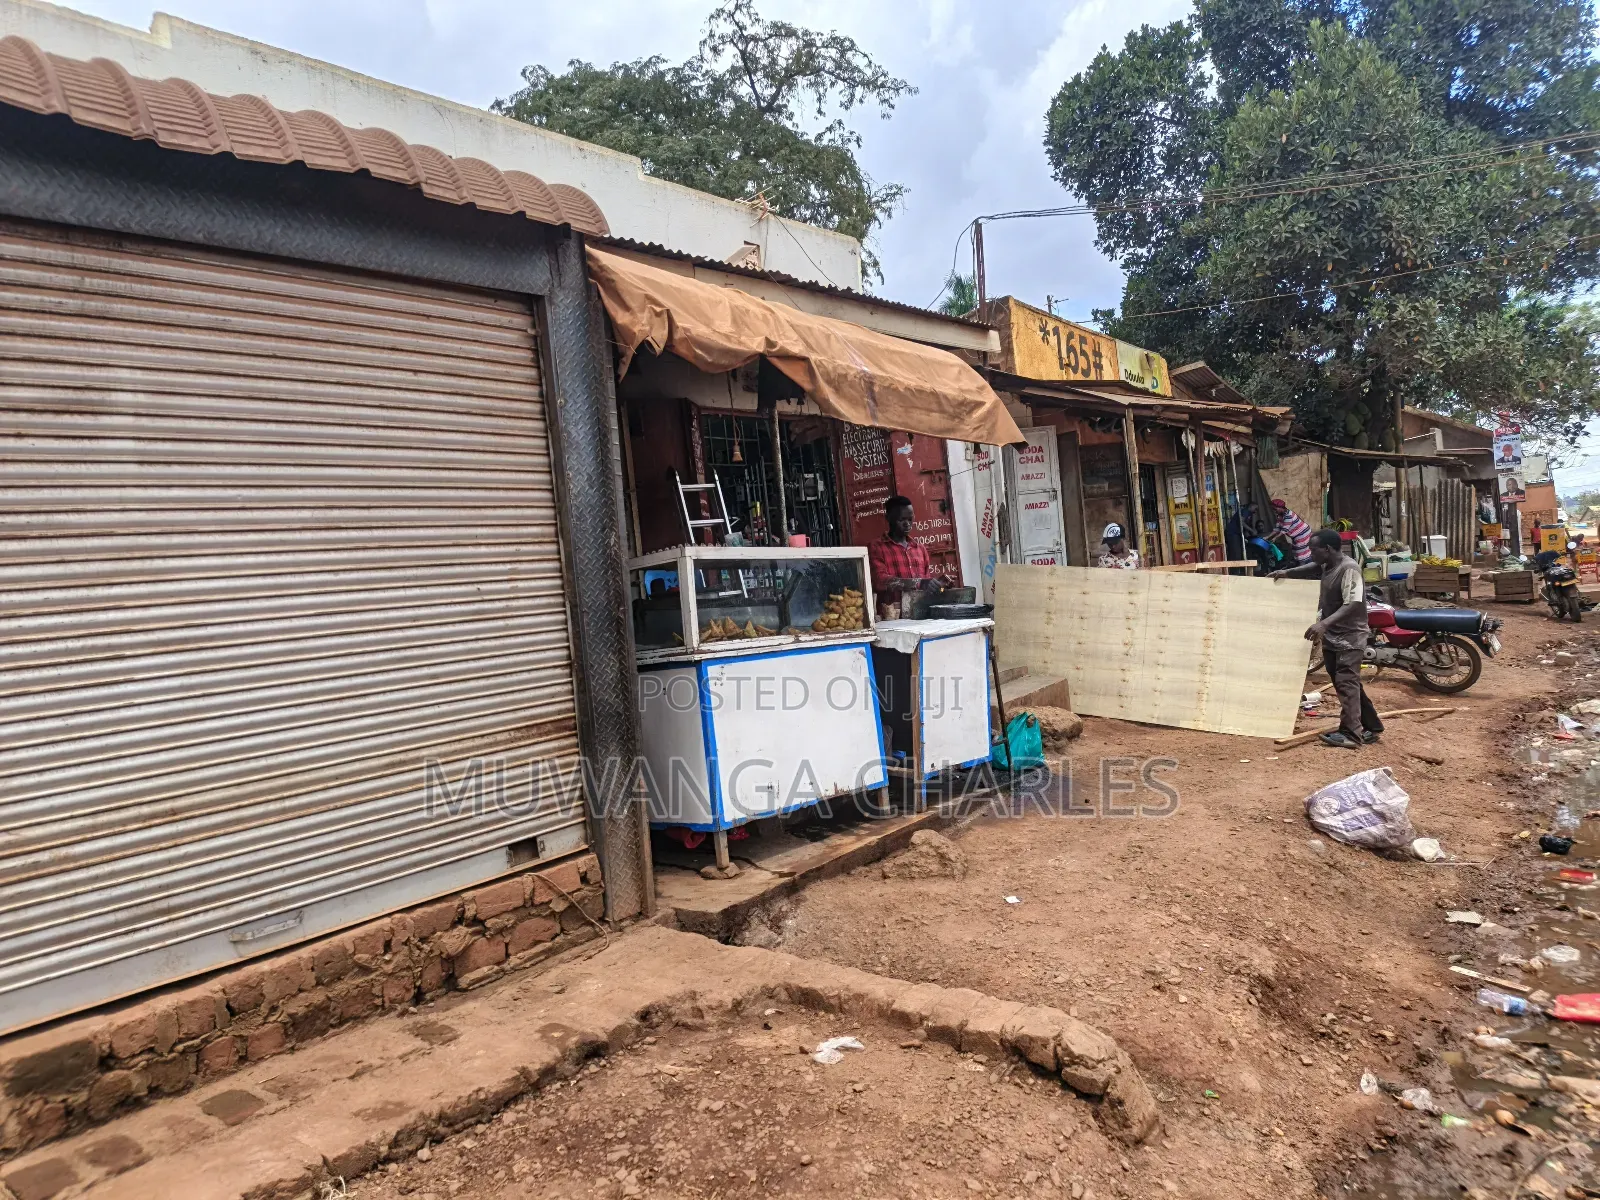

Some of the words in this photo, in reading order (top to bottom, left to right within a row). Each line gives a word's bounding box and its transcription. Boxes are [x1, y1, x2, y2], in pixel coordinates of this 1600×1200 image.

[853, 451, 889, 470] SYSTEMS
[1018, 454, 1045, 465] CHAI
[1020, 472, 1046, 481] AMAZZI
[1024, 501, 1050, 511] AMAZZI
[980, 498, 993, 536] AMATA
[911, 518, 952, 531] 766711862
[1030, 557, 1057, 566] SODA
